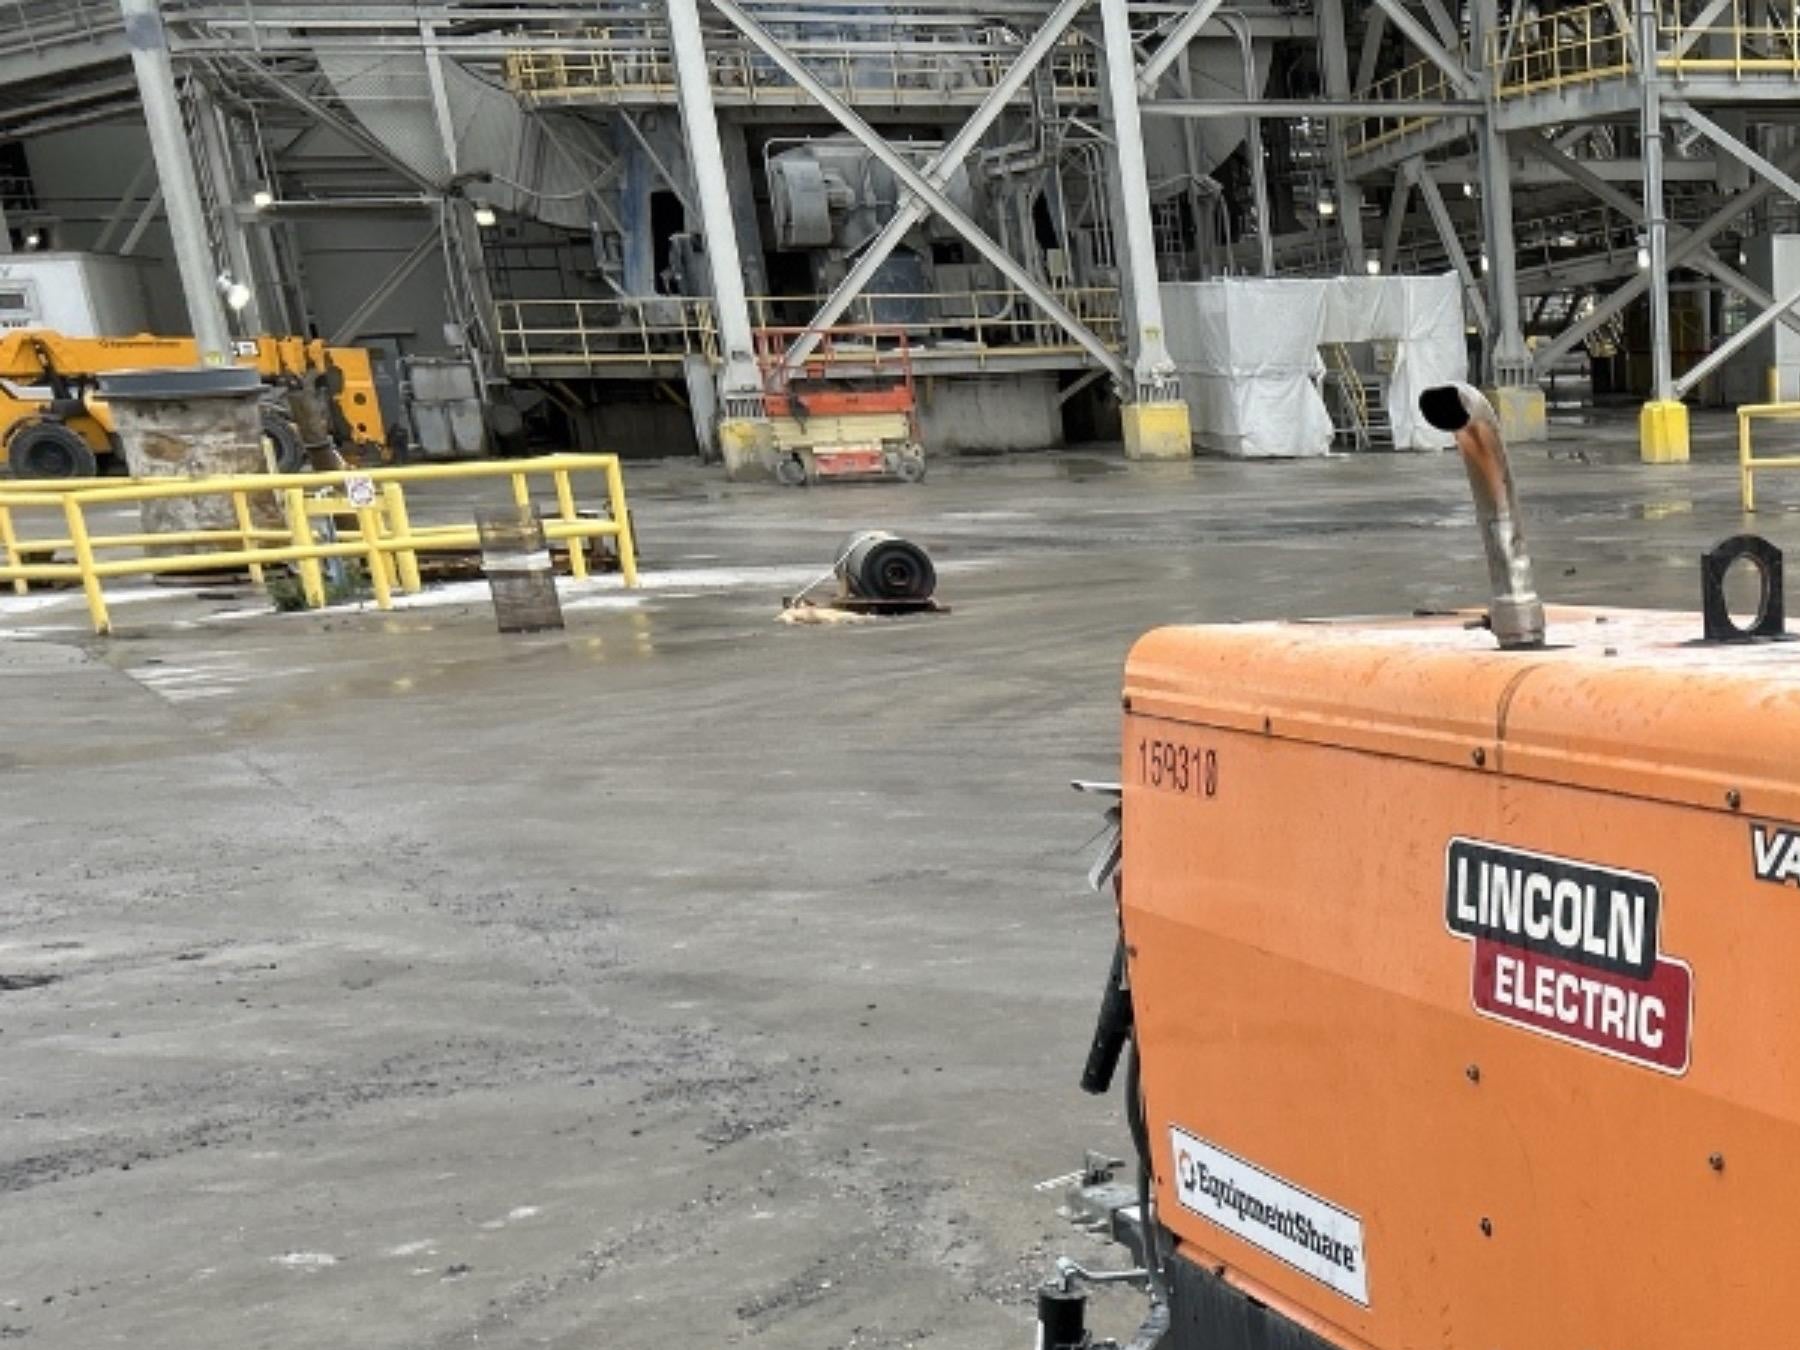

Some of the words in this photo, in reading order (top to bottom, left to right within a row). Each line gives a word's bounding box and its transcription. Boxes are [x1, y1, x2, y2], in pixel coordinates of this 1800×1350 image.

[1139, 739, 1217, 797] 159310
[1456, 857, 1646, 965] LINCOLN
[1494, 955, 1666, 1048] ELECTRIC
[1197, 1160, 1357, 1273] EquipmentShare
